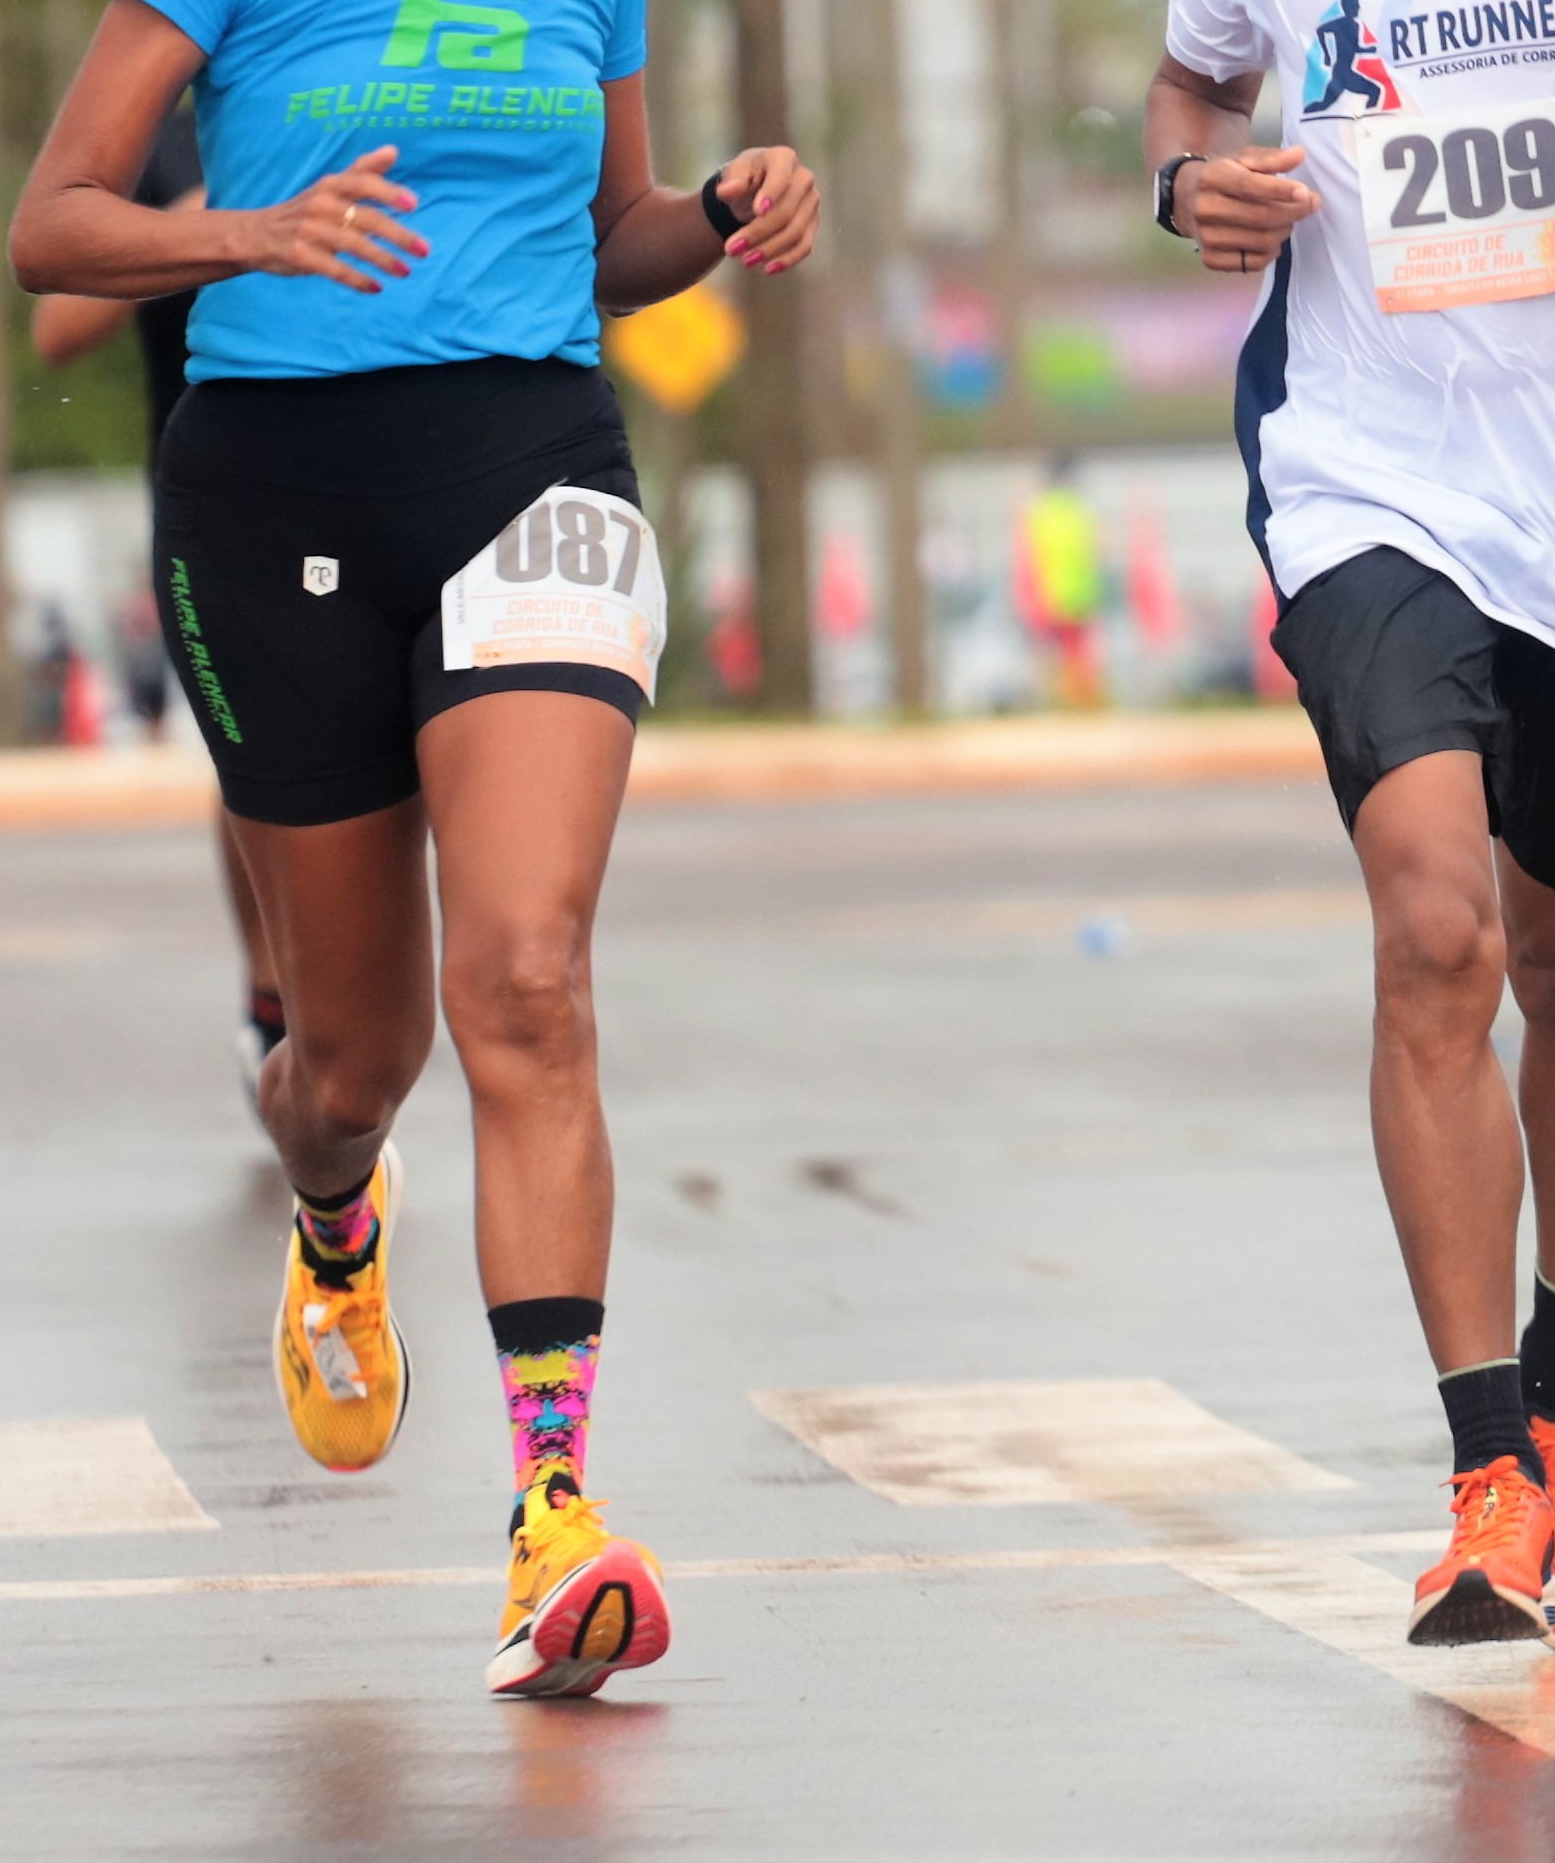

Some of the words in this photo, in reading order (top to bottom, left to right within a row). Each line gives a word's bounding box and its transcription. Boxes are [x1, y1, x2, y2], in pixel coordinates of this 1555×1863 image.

[1389, 14, 1430, 61] RT
[1419, 56, 1498, 80] ASSESSORIA
[1501, 53, 1519, 67] DE
[284, 81, 437, 124] FELIPE
[324, 115, 469, 133] ASSESSORIA
[1406, 237, 1479, 262] CIRCUITO
[1485, 233, 1506, 251] DE
[1393, 259, 1463, 282] CORRIDA
[1468, 256, 1488, 273] DE
[1493, 250, 1525, 268] RUA
[496, 499, 641, 597] 087
[506, 599, 581, 616] CIRCUITO
[585, 601, 605, 618] DE
[492, 617, 563, 635] CORRIDA
[568, 618, 589, 633] DE
[592, 620, 620, 638] RUA
[170, 557, 202, 638] FELIPE
[188, 639, 243, 744] ALENCAR
